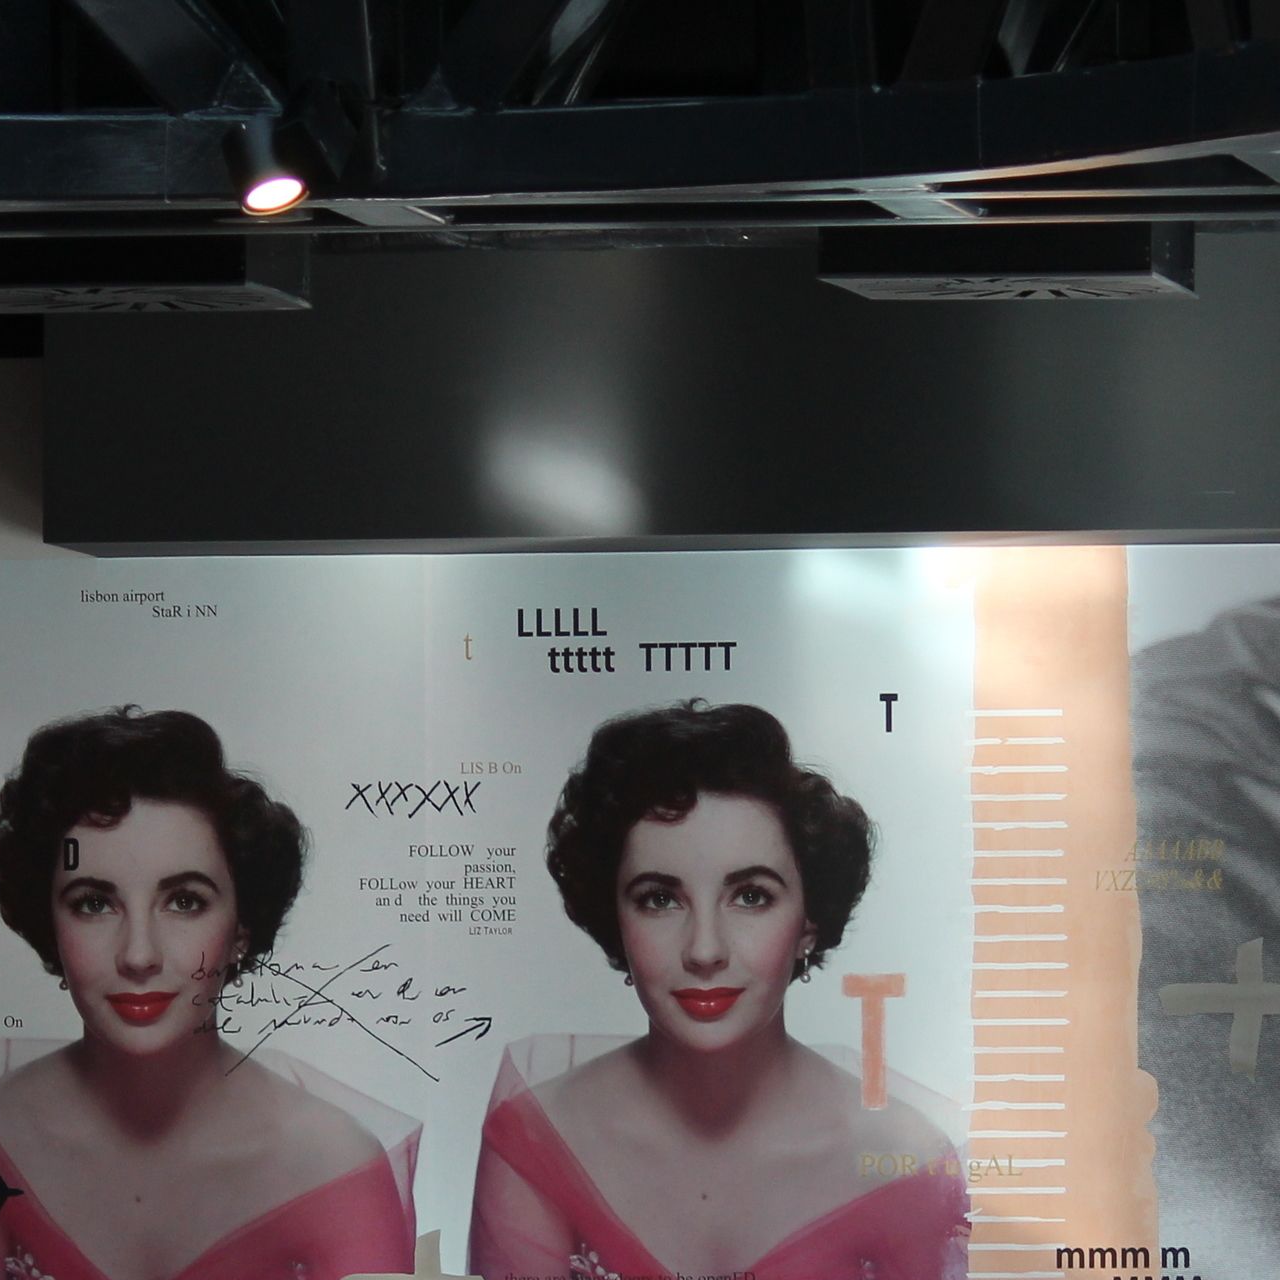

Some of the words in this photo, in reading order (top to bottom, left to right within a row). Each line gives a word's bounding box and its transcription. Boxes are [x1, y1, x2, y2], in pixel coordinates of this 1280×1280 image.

[80, 589, 119, 603] lisbon
[122, 589, 165, 605] airport
[152, 605, 183, 618] StaR
[195, 605, 217, 617] NN
[516, 607, 608, 638] LLLLL
[547, 645, 616, 674] ttttt
[639, 641, 738, 673] TTTTT
[879, 692, 899, 732] T
[460, 761, 484, 775] LIS
[63, 838, 80, 871] D
[408, 844, 475, 858] FOLLOW
[486, 847, 517, 860] your
[463, 861, 517, 876] passion,
[359, 877, 418, 890] FOLLow
[425, 880, 456, 893] your
[463, 877, 517, 889] HEART
[418, 893, 438, 907] the
[445, 893, 485, 909] things
[492, 895, 517, 909] you
[399, 910, 431, 922] need
[438, 909, 463, 922] will
[470, 909, 517, 922] COME
[469, 926, 482, 935] LIZ
[4, 1015, 24, 1028] On
[841, 972, 907, 1111] T
